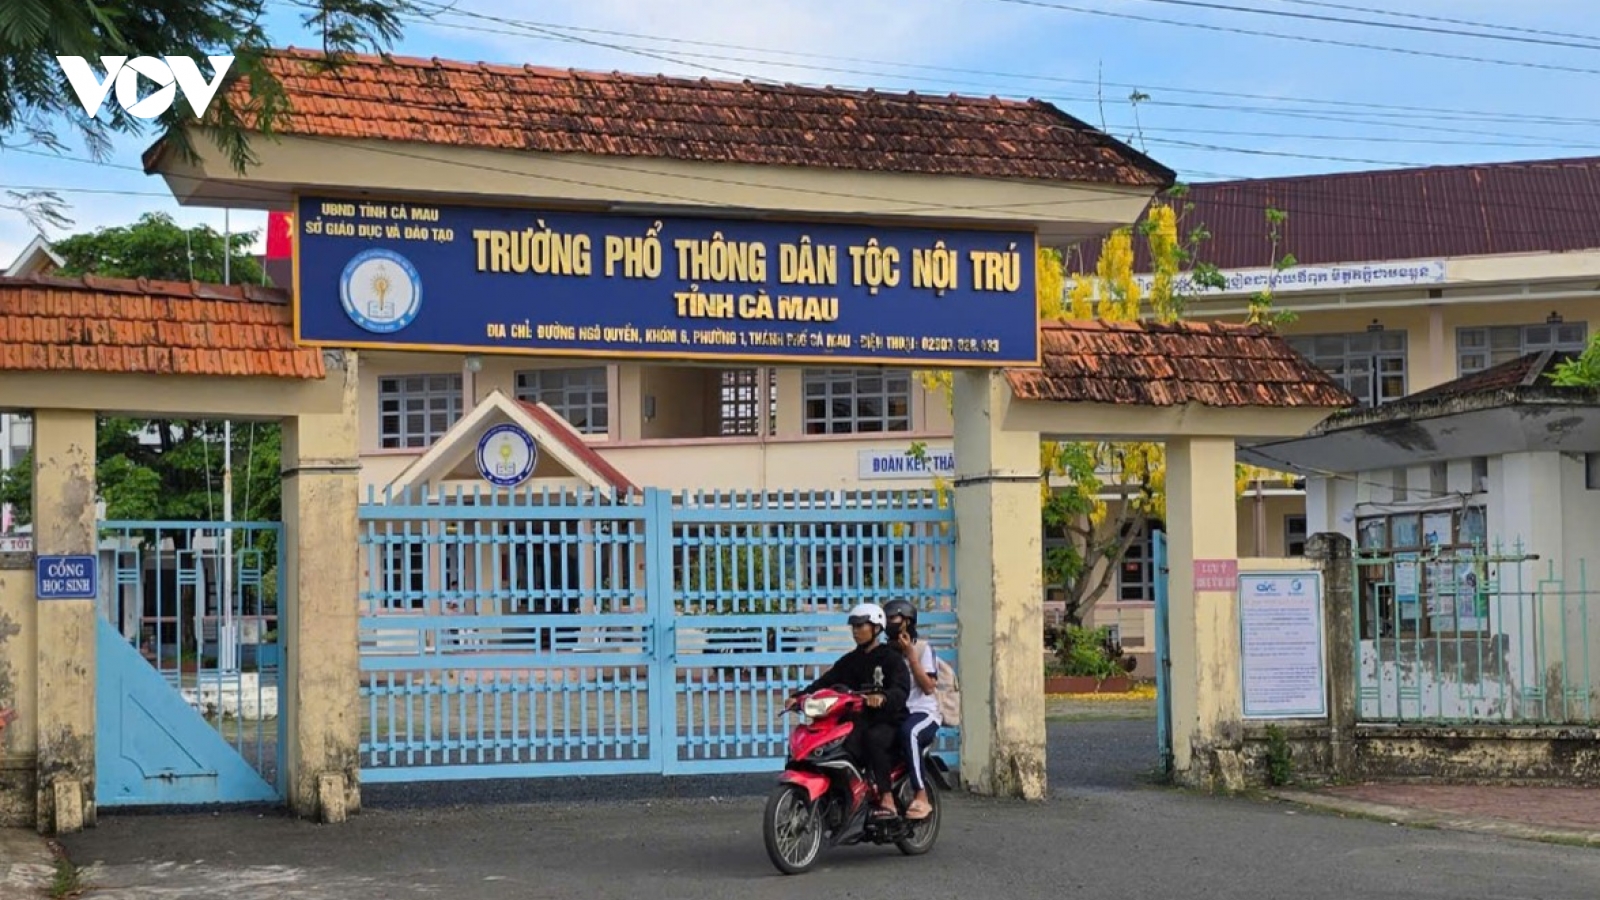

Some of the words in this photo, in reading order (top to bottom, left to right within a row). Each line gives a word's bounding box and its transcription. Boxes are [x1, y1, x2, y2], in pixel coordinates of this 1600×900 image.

[321, 203, 355, 216] UBND
[359, 202, 387, 218] TỈNH
[391, 205, 408, 219] CÀ
[411, 208, 439, 221] MAU
[305, 216, 322, 234] SỞ
[325, 220, 355, 236] GIÁO
[358, 225, 382, 240] DỤC
[386, 223, 400, 239] VÀ
[404, 224, 428, 241] ĐÀO
[432, 229, 454, 243] TẠO
[473, 219, 592, 276] TRƯỜNG
[605, 220, 663, 279] PHỔ
[674, 231, 767, 282] THÔNG
[779, 235, 837, 285] DÂN
[849, 238, 900, 295] TỘC
[912, 241, 958, 296] NỘI
[970, 242, 1021, 292] TRÚ
[674, 284, 734, 319] TỈNH
[739, 289, 774, 319] CÀ
[777, 295, 838, 321] MAU
[537, 321, 575, 340] ĐƯỜNG
[579, 325, 601, 341] NGÔ
[645, 325, 677, 343] KHÓM
[680, 329, 691, 345] 6,
[693, 327, 737, 345] PHƯỜNG
[826, 334, 851, 348] MAU
[872, 454, 903, 473] ĐOÀN
[48, 558, 84, 578] CỔNG
[42, 579, 65, 595] HỌC
[66, 579, 91, 593] SINH
